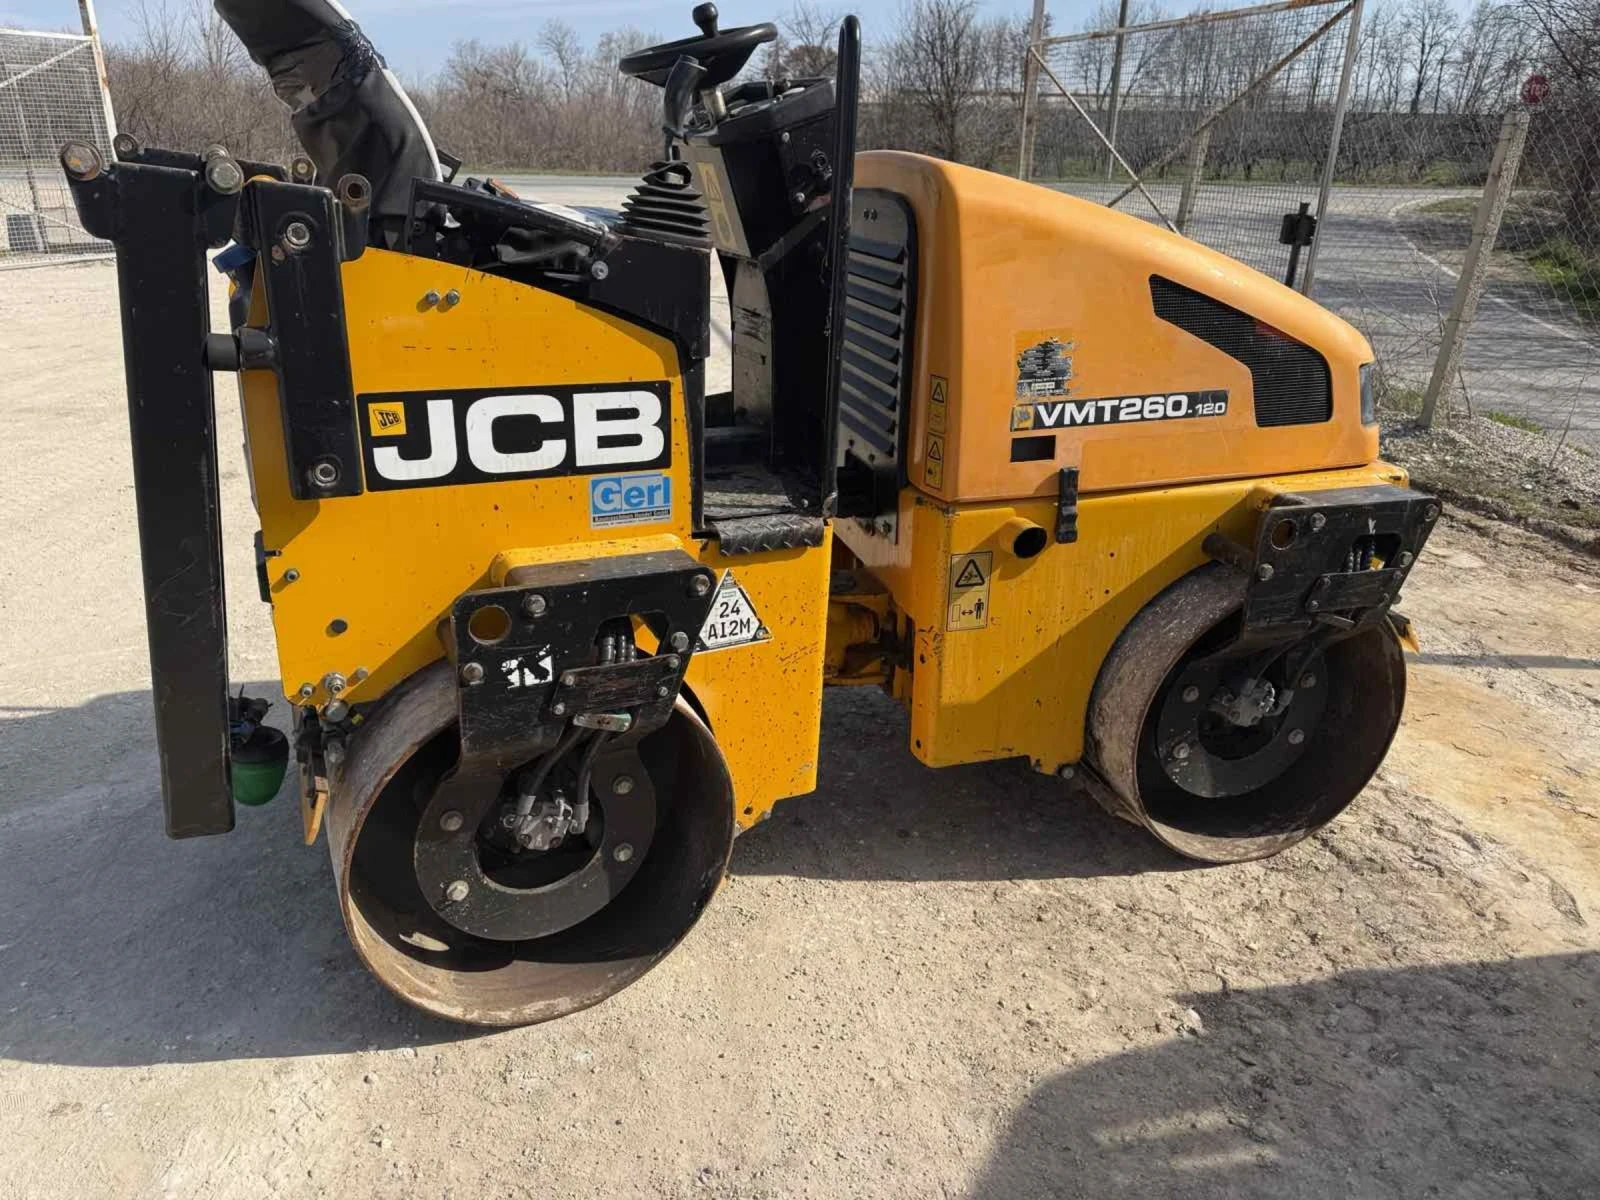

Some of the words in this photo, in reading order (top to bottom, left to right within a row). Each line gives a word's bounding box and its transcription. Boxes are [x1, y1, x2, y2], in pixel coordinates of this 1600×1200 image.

[378, 411, 400, 427] JCB
[373, 390, 665, 481] JCB
[593, 476, 670, 512] Gerl
[719, 600, 741, 619] 24
